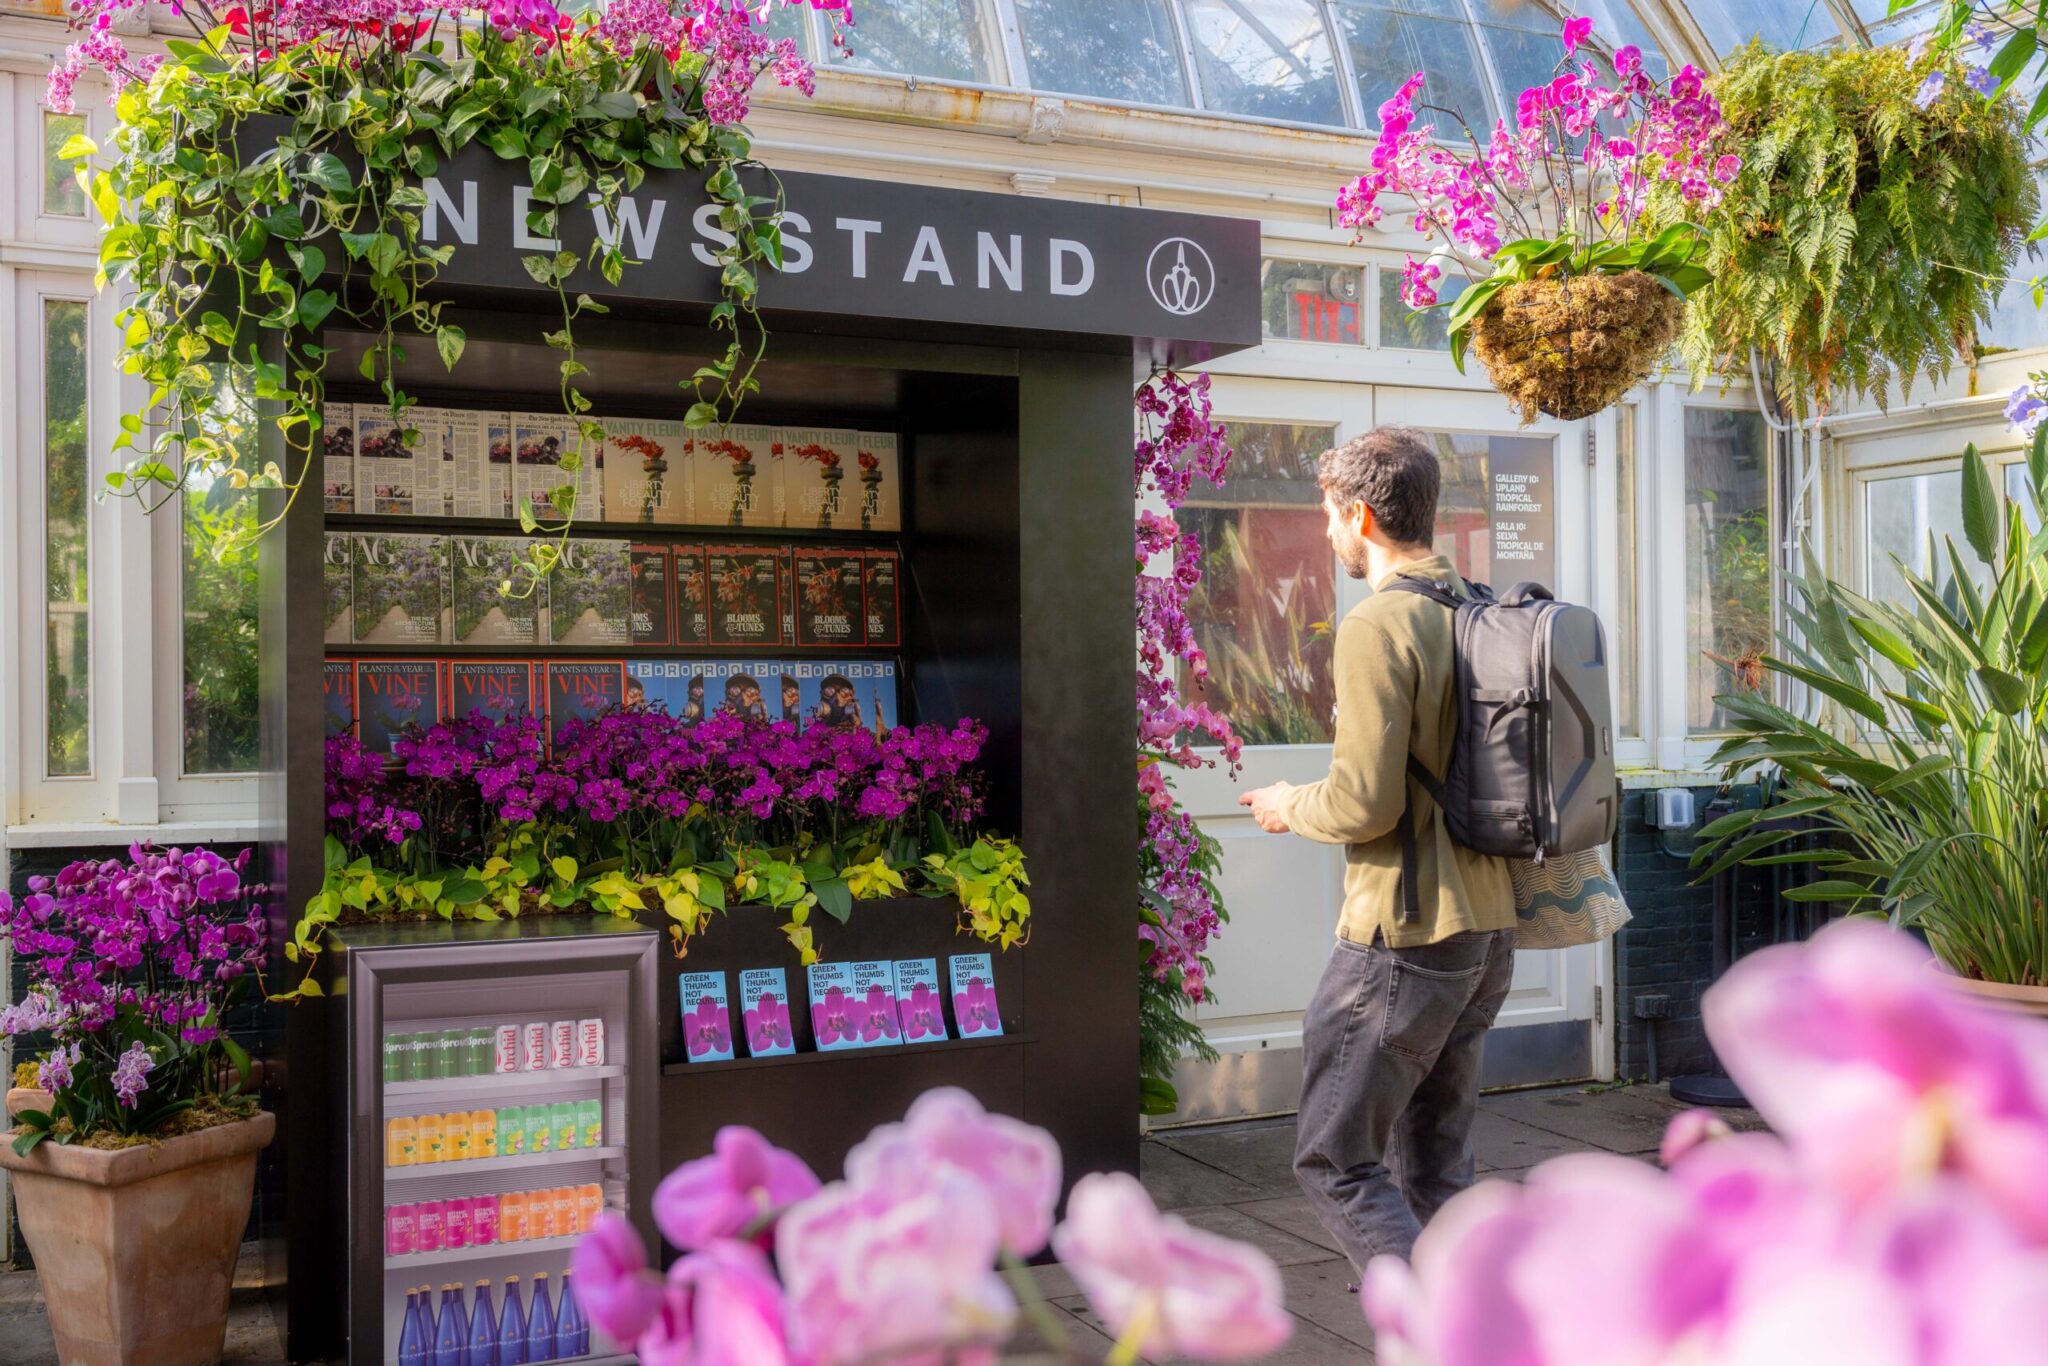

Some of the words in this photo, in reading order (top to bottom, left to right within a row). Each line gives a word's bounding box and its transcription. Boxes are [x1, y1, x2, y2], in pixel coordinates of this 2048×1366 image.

[421, 177, 1095, 297] NEWSSTAND
[606, 421, 643, 436] VANITY
[647, 423, 681, 438] FLEUR
[736, 427, 769, 442] FLEUR
[785, 430, 821, 445] VANITY
[824, 431, 857, 446] FLEUR
[864, 434, 895, 449] FLEUR
[1496, 474, 1528, 483] GALLERY
[624, 480, 666, 490] LIBERTY
[714, 484, 754, 494] LIBERTY
[1496, 484, 1526, 493] UPLAND
[629, 489, 672, 500] BEAUTY
[803, 487, 841, 497] LIBERTY
[719, 493, 761, 503] BEAUTY
[809, 496, 848, 507] BEAUTY
[1496, 493, 1532, 502] TROPICAL
[622, 498, 645, 508] FOR
[713, 502, 733, 511] FOR
[1496, 502, 1542, 512] RAINFOREST
[803, 504, 821, 513] FOR
[1496, 522, 1515, 531] SALA
[1496, 532, 1519, 540] SELVA
[324, 536, 350, 565] G
[353, 536, 395, 565] AG
[1496, 541, 1532, 551] TROPICAL
[1533, 542, 1544, 551] DE
[452, 539, 493, 568] AG
[1496, 550, 1534, 560] MONTAÑA
[727, 614, 761, 624] BLOOMS
[814, 616, 847, 624] BLOOMS
[360, 664, 392, 673] PLANTS
[401, 665, 424, 674] YEAR
[455, 665, 486, 674] PLANTS
[495, 666, 517, 674] YEAR
[551, 665, 582, 674] PLANTS
[589, 666, 610, 674] YEAR
[703, 663, 780, 678] ROOTED
[796, 664, 874, 678] ROOTED
[367, 674, 429, 695] VINE
[462, 675, 521, 695] VINE
[557, 674, 615, 695] VINE
[955, 956, 977, 964] GREEN
[811, 965, 836, 973] GREEN
[854, 963, 877, 971] GREEN
[899, 961, 922, 969] GREEN
[955, 963, 984, 971] THUMBS
[745, 971, 770, 979] GREEN
[812, 972, 844, 980] THUMBS
[855, 970, 885, 978] THUMBS
[900, 969, 929, 977] THUMBS
[684, 974, 709, 982] GREEN
[746, 978, 777, 986] THUMBS
[957, 978, 992, 986] REQUIRED
[685, 982, 717, 990] THUMBS
[856, 985, 892, 994] REQUIRED
[901, 984, 936, 992] REQUIRED
[686, 990, 702, 998] NOT
[814, 987, 851, 995] REQUIRED
[686, 997, 725, 1005] REQUIRED
[747, 994, 785, 1002] REQUIRED
[559, 1025, 571, 1066] Orchid
[585, 1023, 597, 1064] Orchid
[503, 1030, 516, 1071] Orchid
[532, 1028, 544, 1069] Orchid
